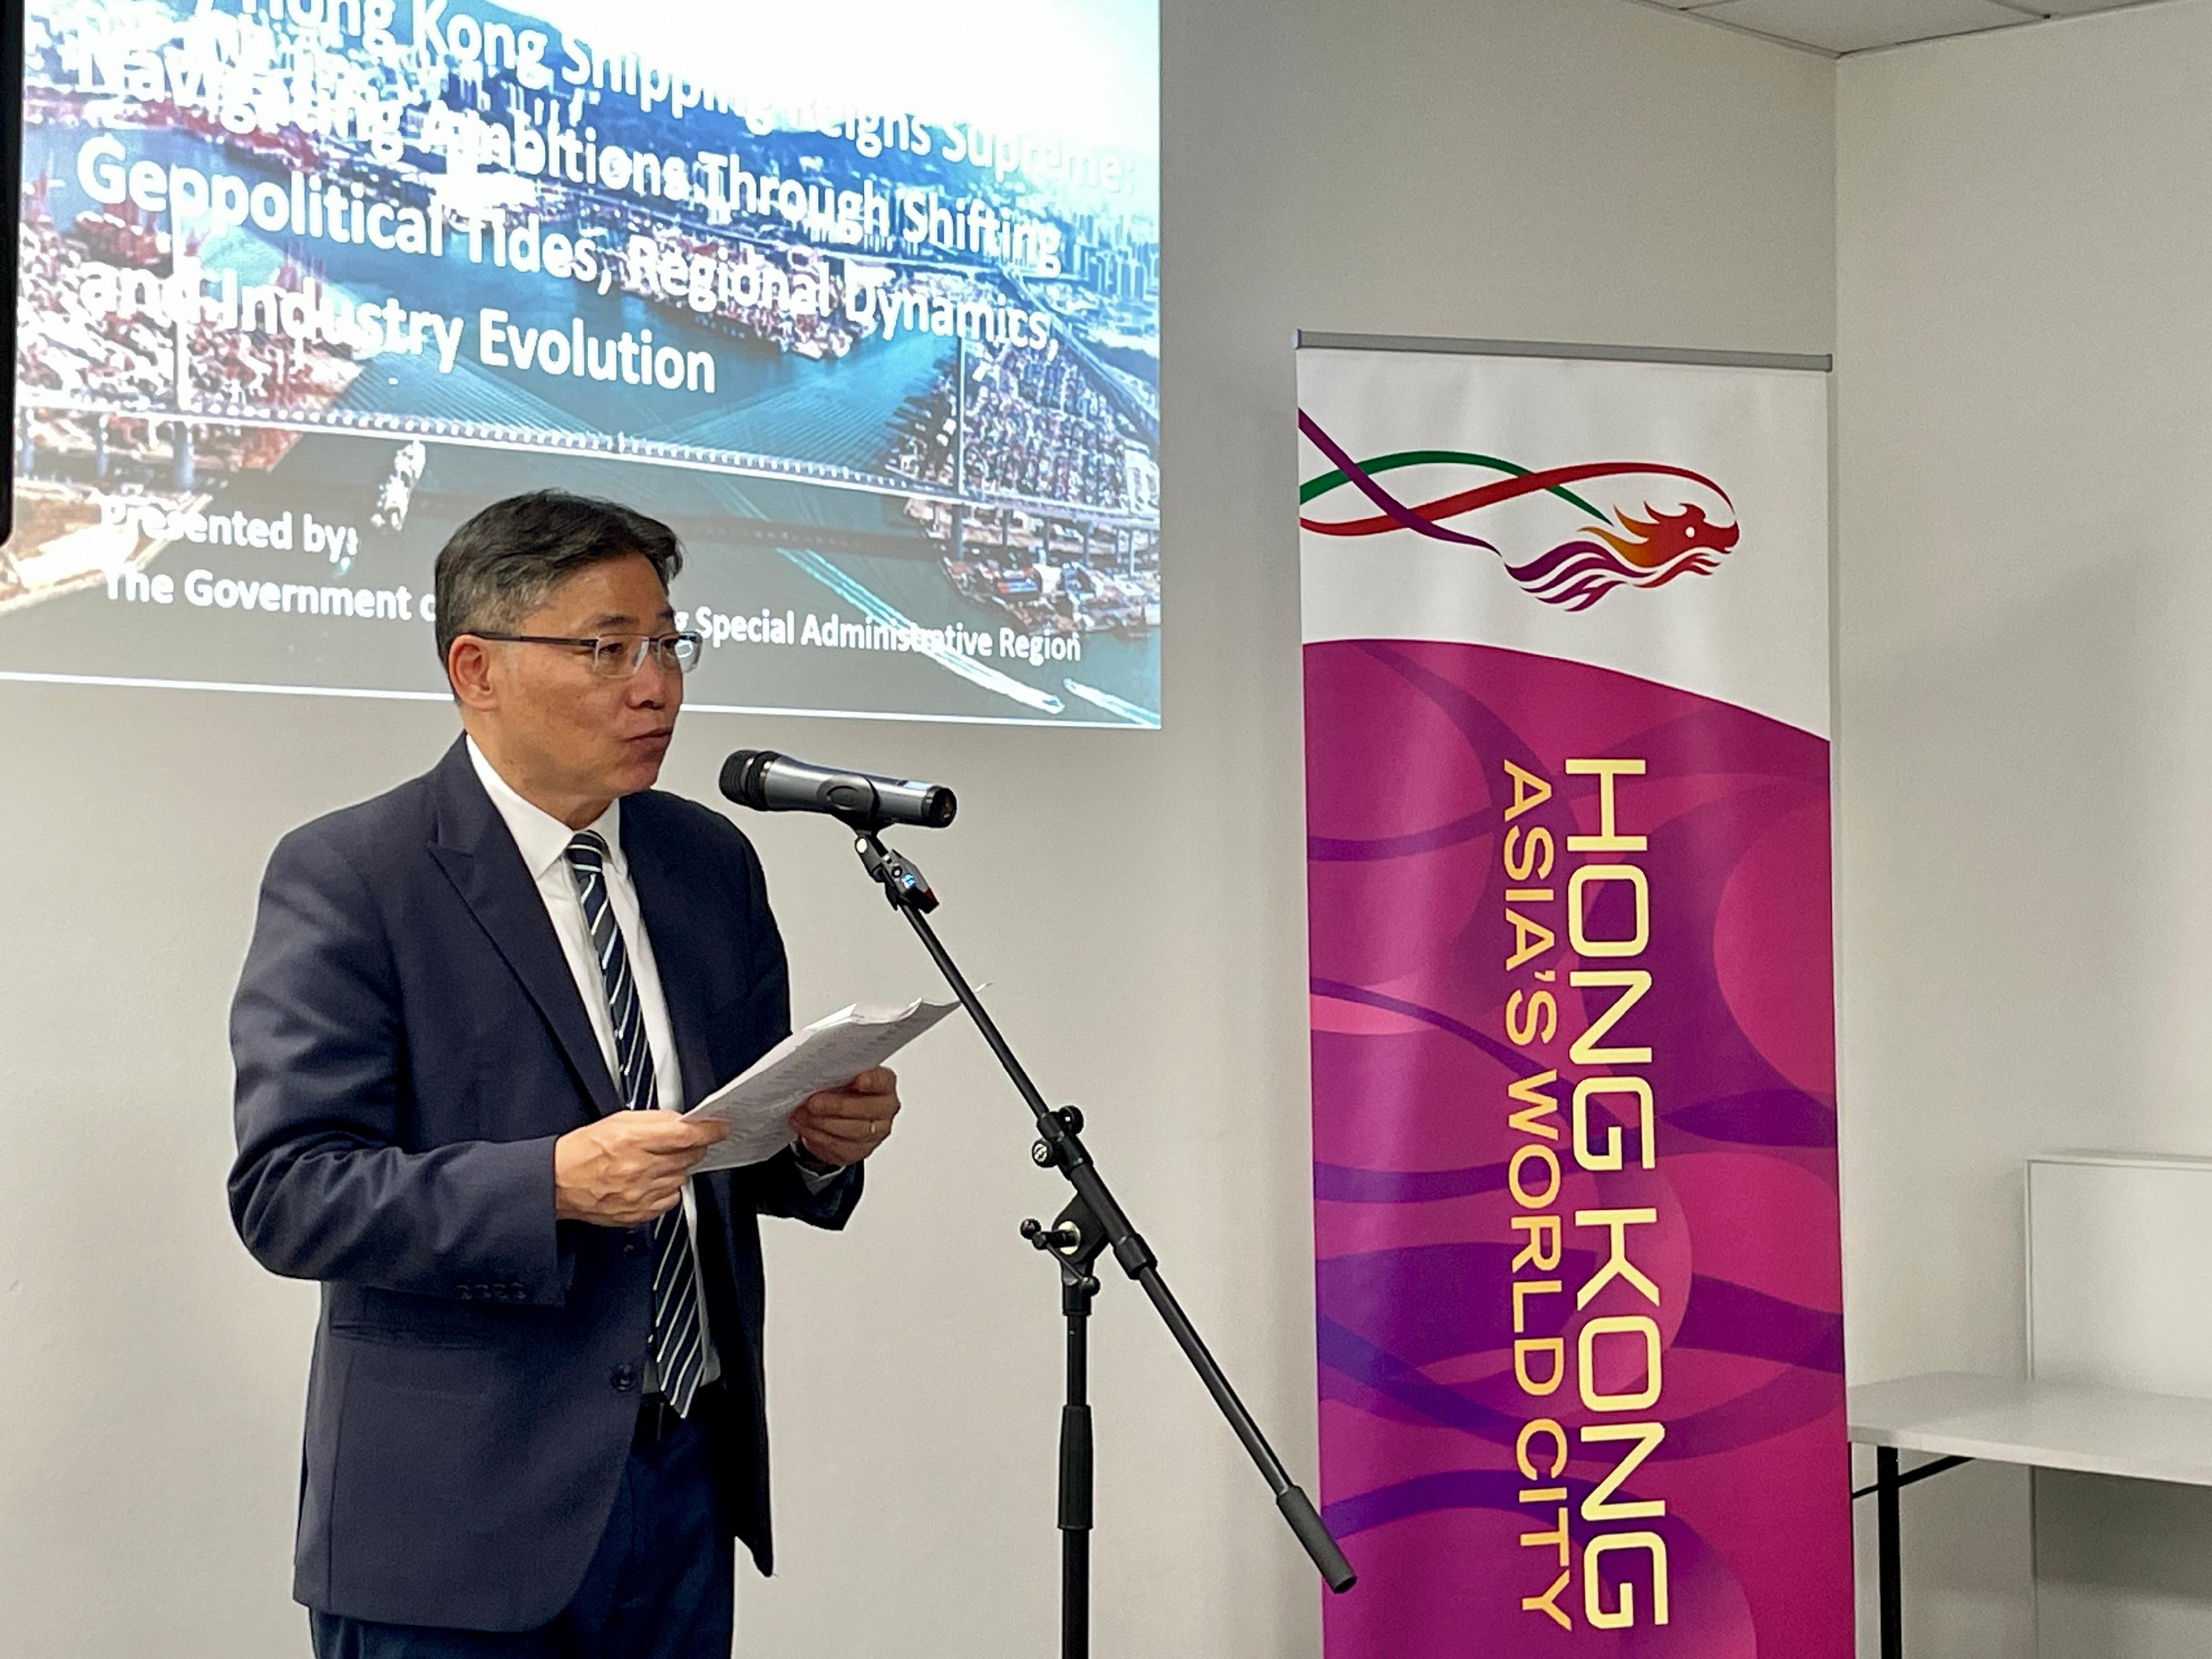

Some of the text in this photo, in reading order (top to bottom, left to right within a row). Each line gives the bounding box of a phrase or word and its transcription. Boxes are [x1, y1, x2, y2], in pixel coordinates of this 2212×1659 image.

[243, 0, 397, 58] ong
[412, 0, 545, 89] Kong
[698, 150, 885, 244] Through
[903, 190, 1062, 278] Shifting
[80, 260, 715, 393] and Industry Evolution
[458, 204, 611, 296] Tides,
[629, 234, 831, 316] Regional
[846, 267, 1058, 362] Dynamics,
[102, 500, 293, 550] Presented
[101, 568, 174, 603] The
[184, 569, 413, 620] Government
[695, 606, 795, 649] Special
[800, 613, 992, 656] Administrative
[999, 628, 1081, 666] Region
[1503, 759, 1572, 1632] ASIA'S WORLD CITY
[1566, 758, 1668, 1629] HONG KONG
